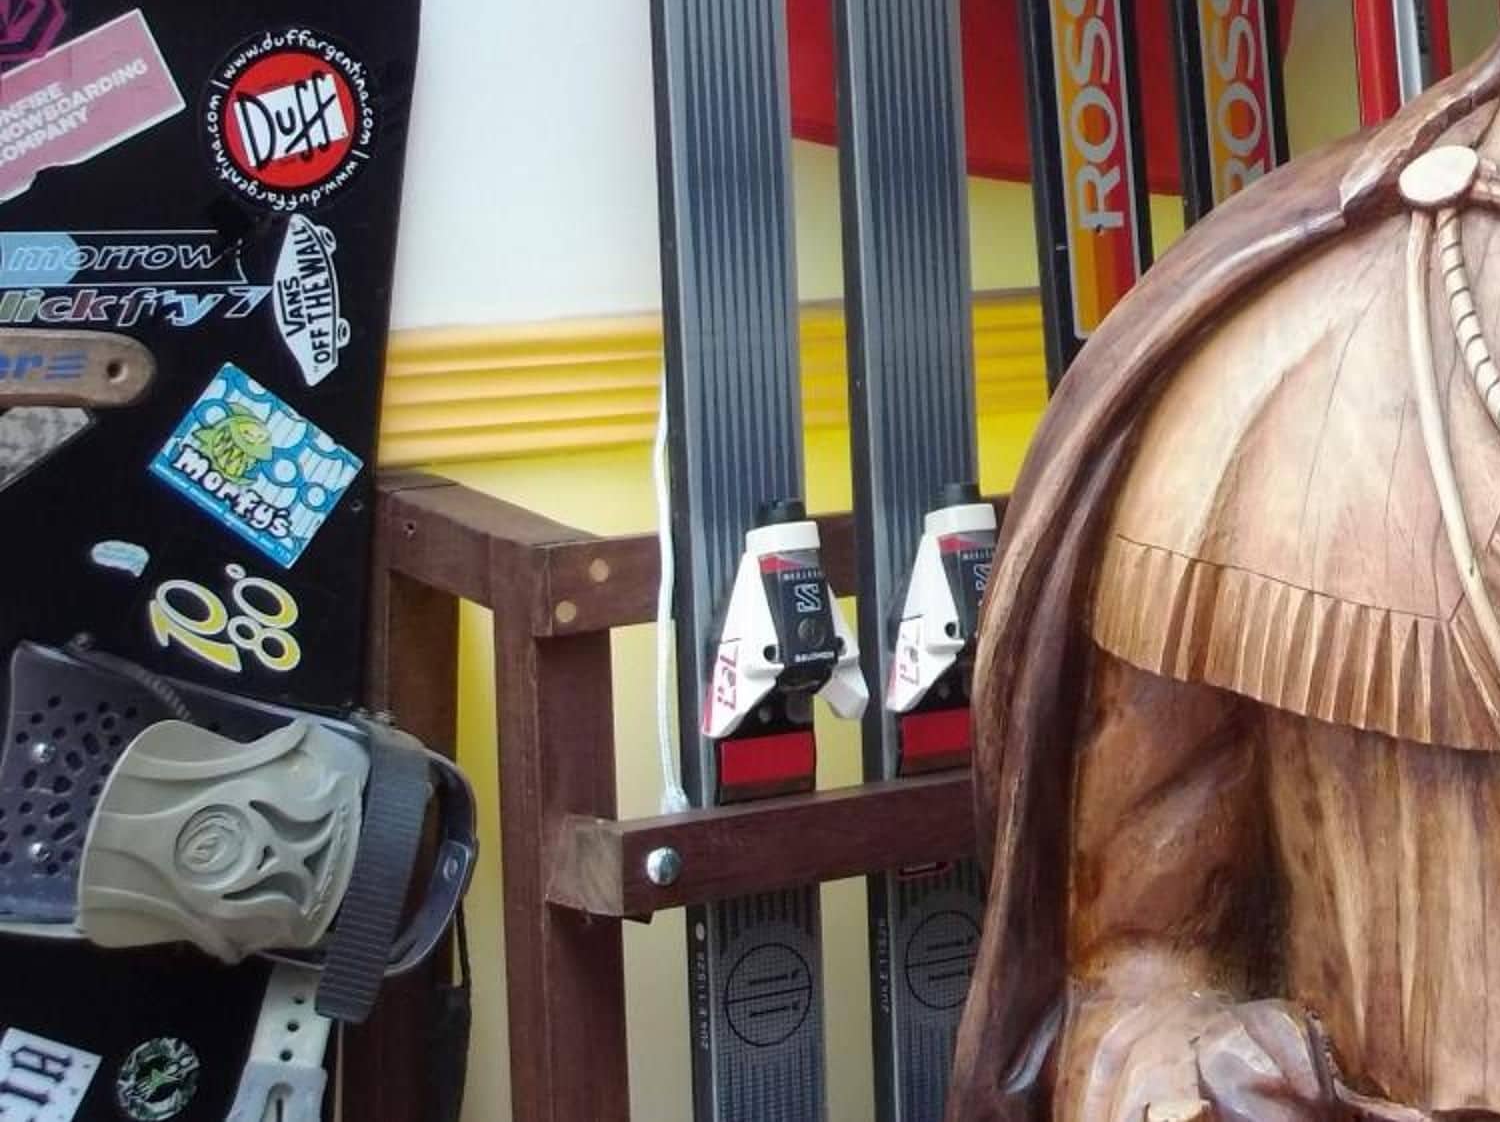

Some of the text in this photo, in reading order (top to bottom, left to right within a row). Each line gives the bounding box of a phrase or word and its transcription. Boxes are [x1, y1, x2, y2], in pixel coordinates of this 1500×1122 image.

[9, 245, 224, 272] morrow
[278, 275, 307, 338] VANS
[302, 277, 332, 326] THE
